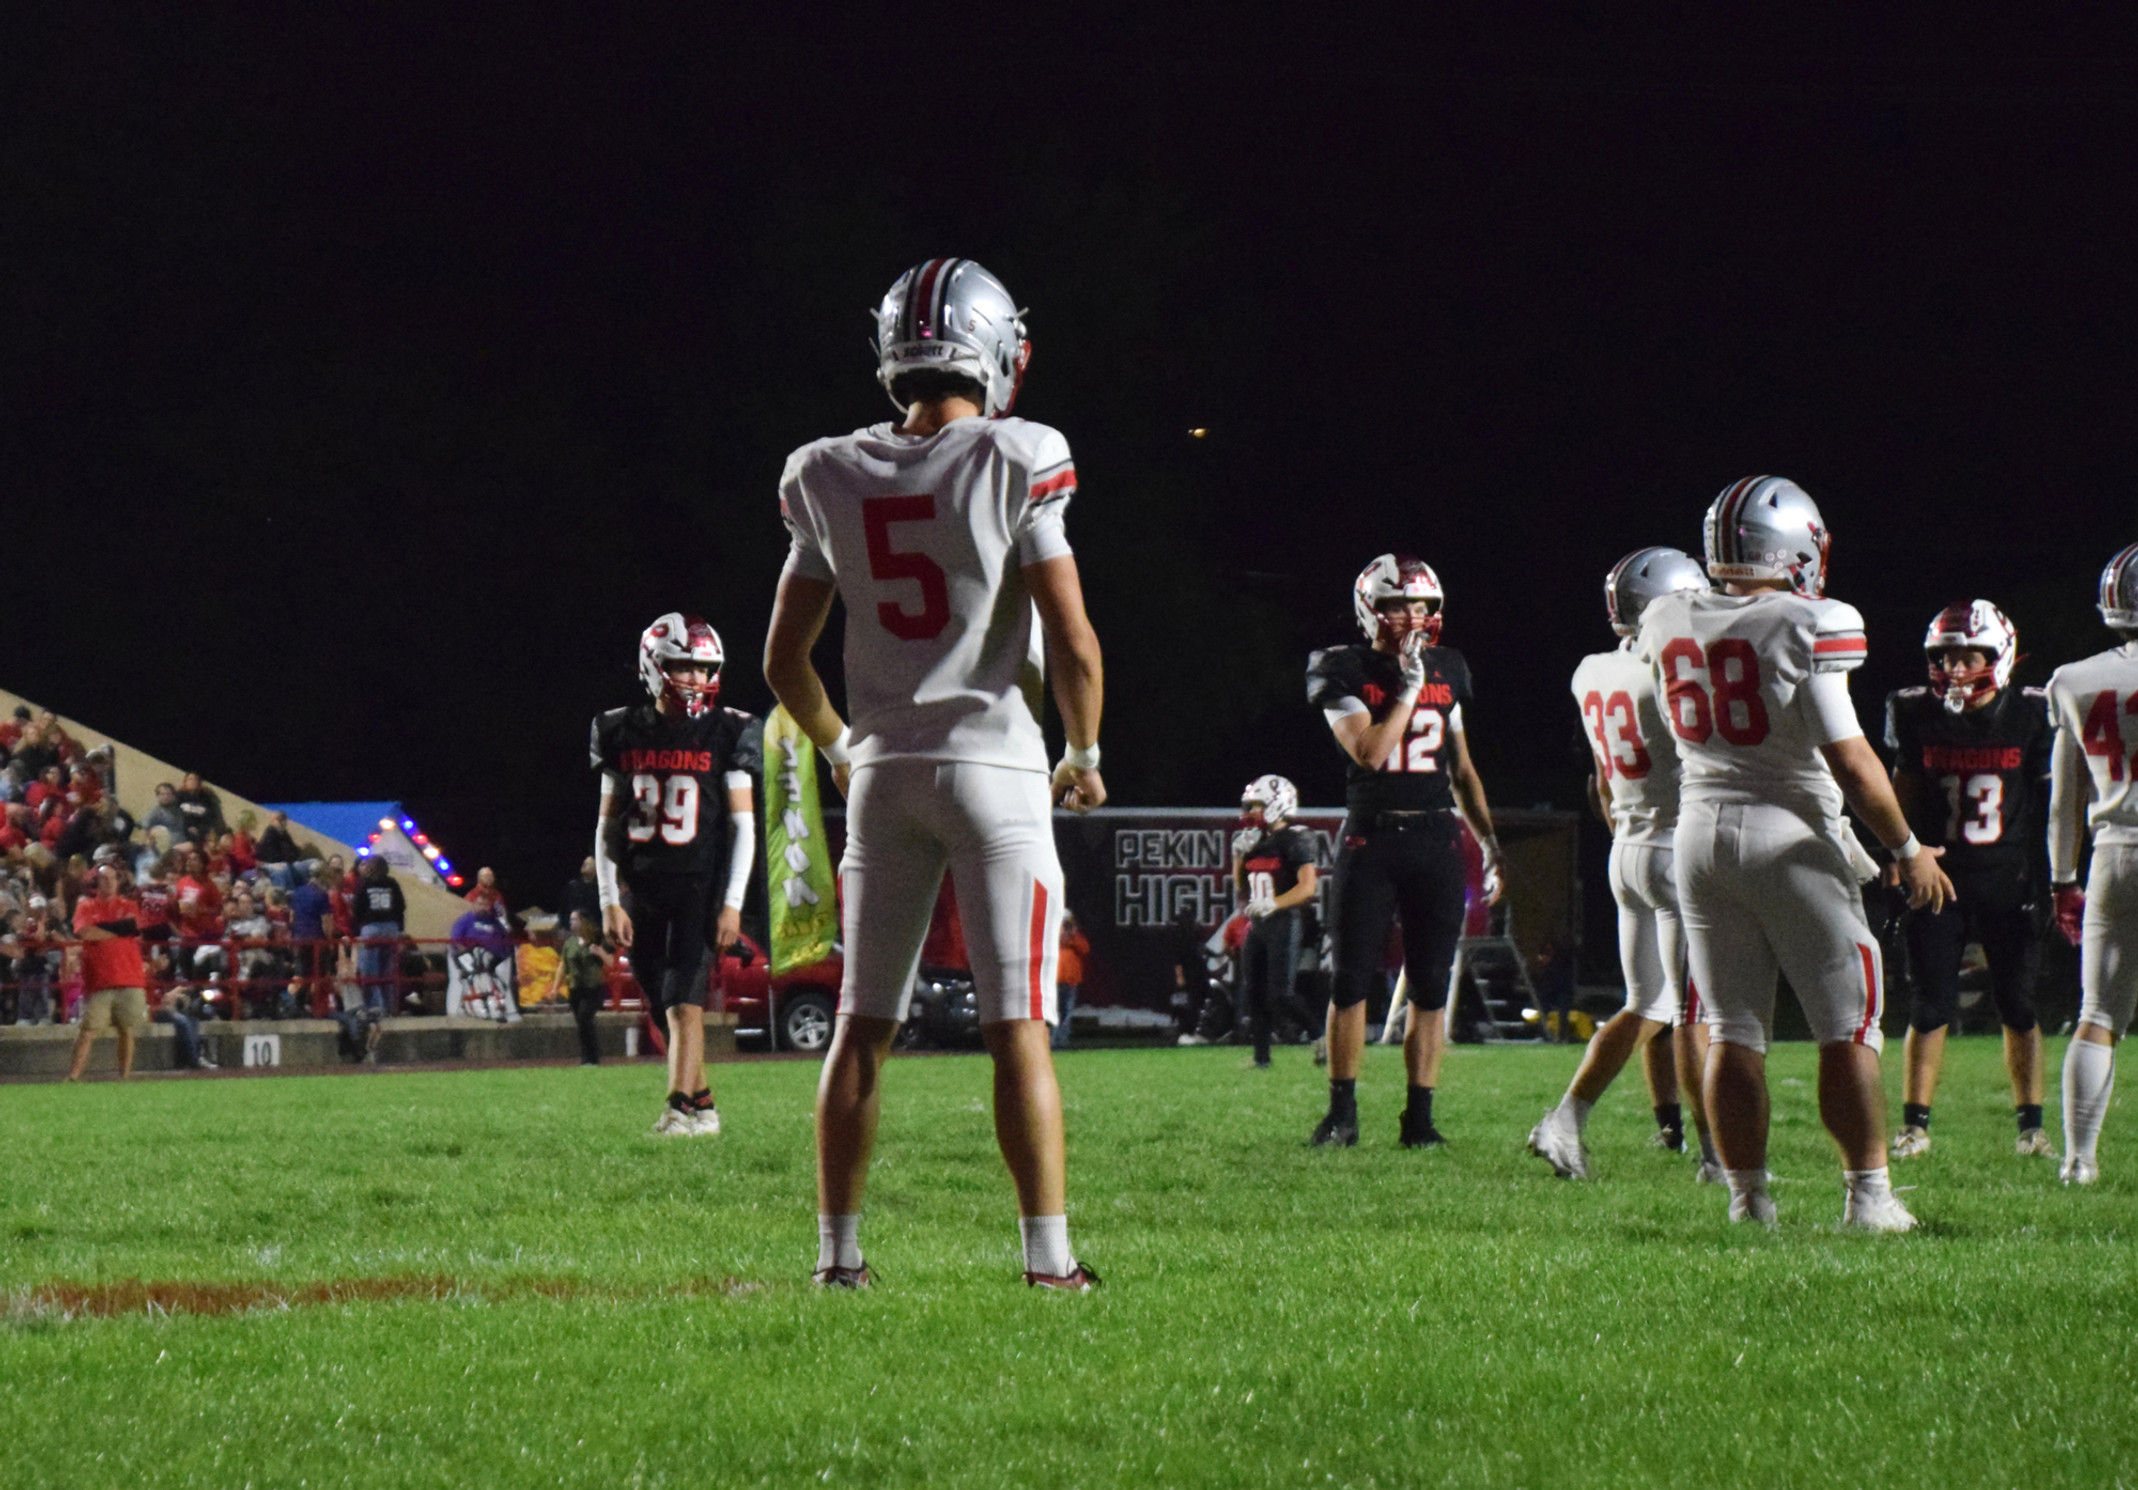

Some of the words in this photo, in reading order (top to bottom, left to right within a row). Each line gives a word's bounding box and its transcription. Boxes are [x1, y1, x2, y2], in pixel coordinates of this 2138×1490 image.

[862, 494, 950, 640] 5
[1661, 637, 1770, 746] 68
[620, 749, 712, 772] DRAGONS
[1583, 690, 1652, 780] 33
[628, 774, 699, 845] 39
[1940, 773, 2004, 845] 13
[1115, 829, 1225, 869] PEKIN
[1115, 874, 1238, 926] HIGH
[251, 1040, 272, 1067] 10
